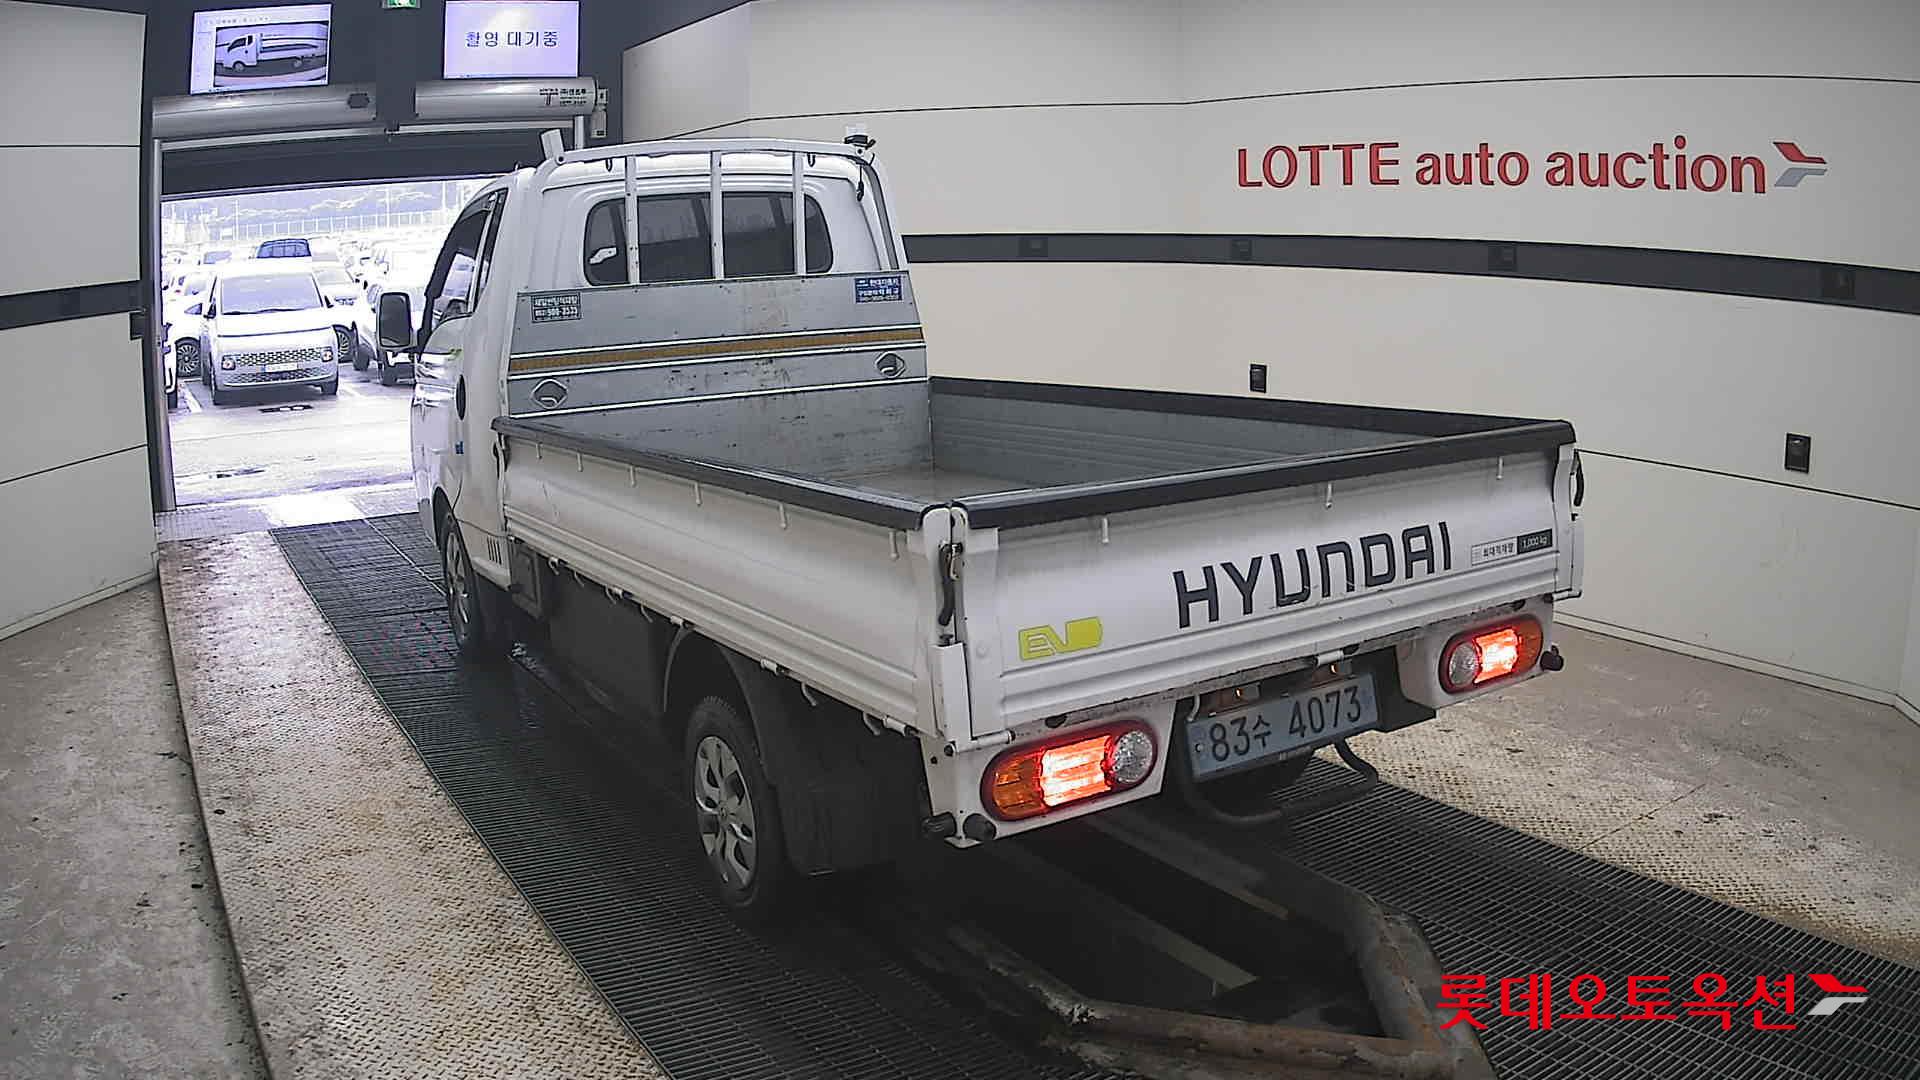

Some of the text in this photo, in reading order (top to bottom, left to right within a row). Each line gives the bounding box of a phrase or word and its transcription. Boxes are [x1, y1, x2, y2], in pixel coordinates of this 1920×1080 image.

[506, 31, 559, 48] 대기중
[1237, 135, 1766, 194] LOTTE auto auction
[1173, 521, 1452, 629] HYUNDAI
[1208, 685, 1362, 762] 83수 4073
